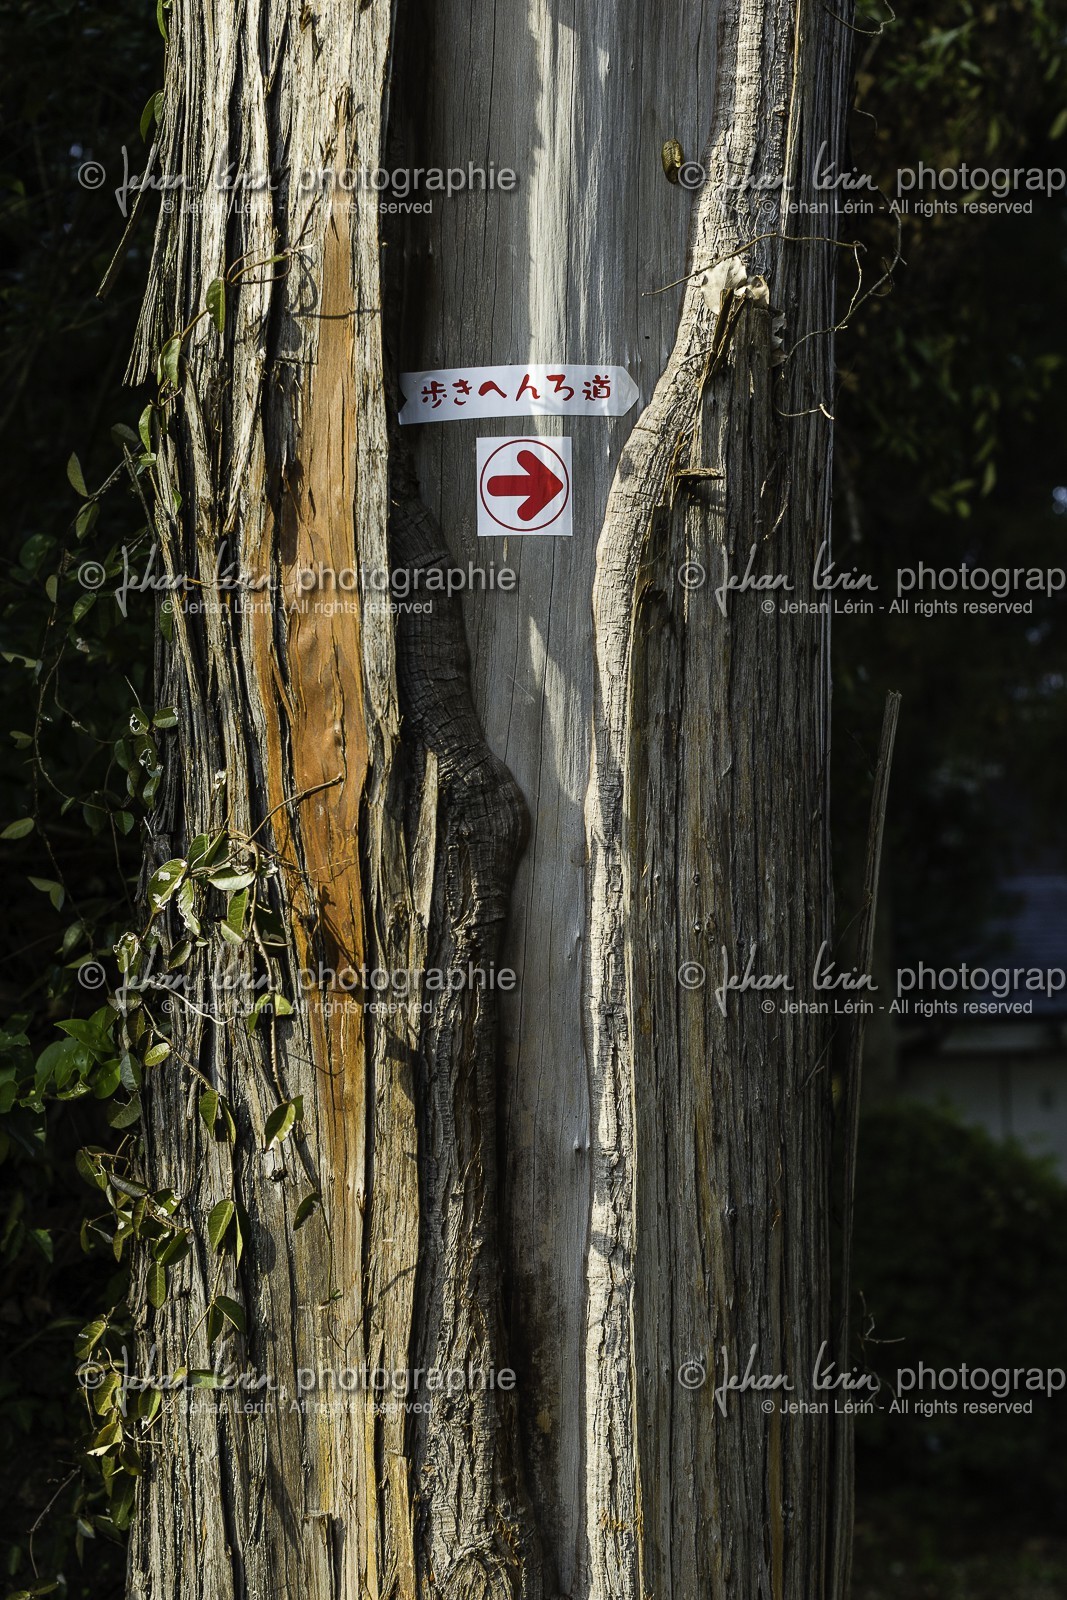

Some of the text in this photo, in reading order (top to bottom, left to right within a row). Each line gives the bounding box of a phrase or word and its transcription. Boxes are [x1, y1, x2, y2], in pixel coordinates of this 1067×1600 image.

[420, 373, 612, 409] 歩きへんろ道
